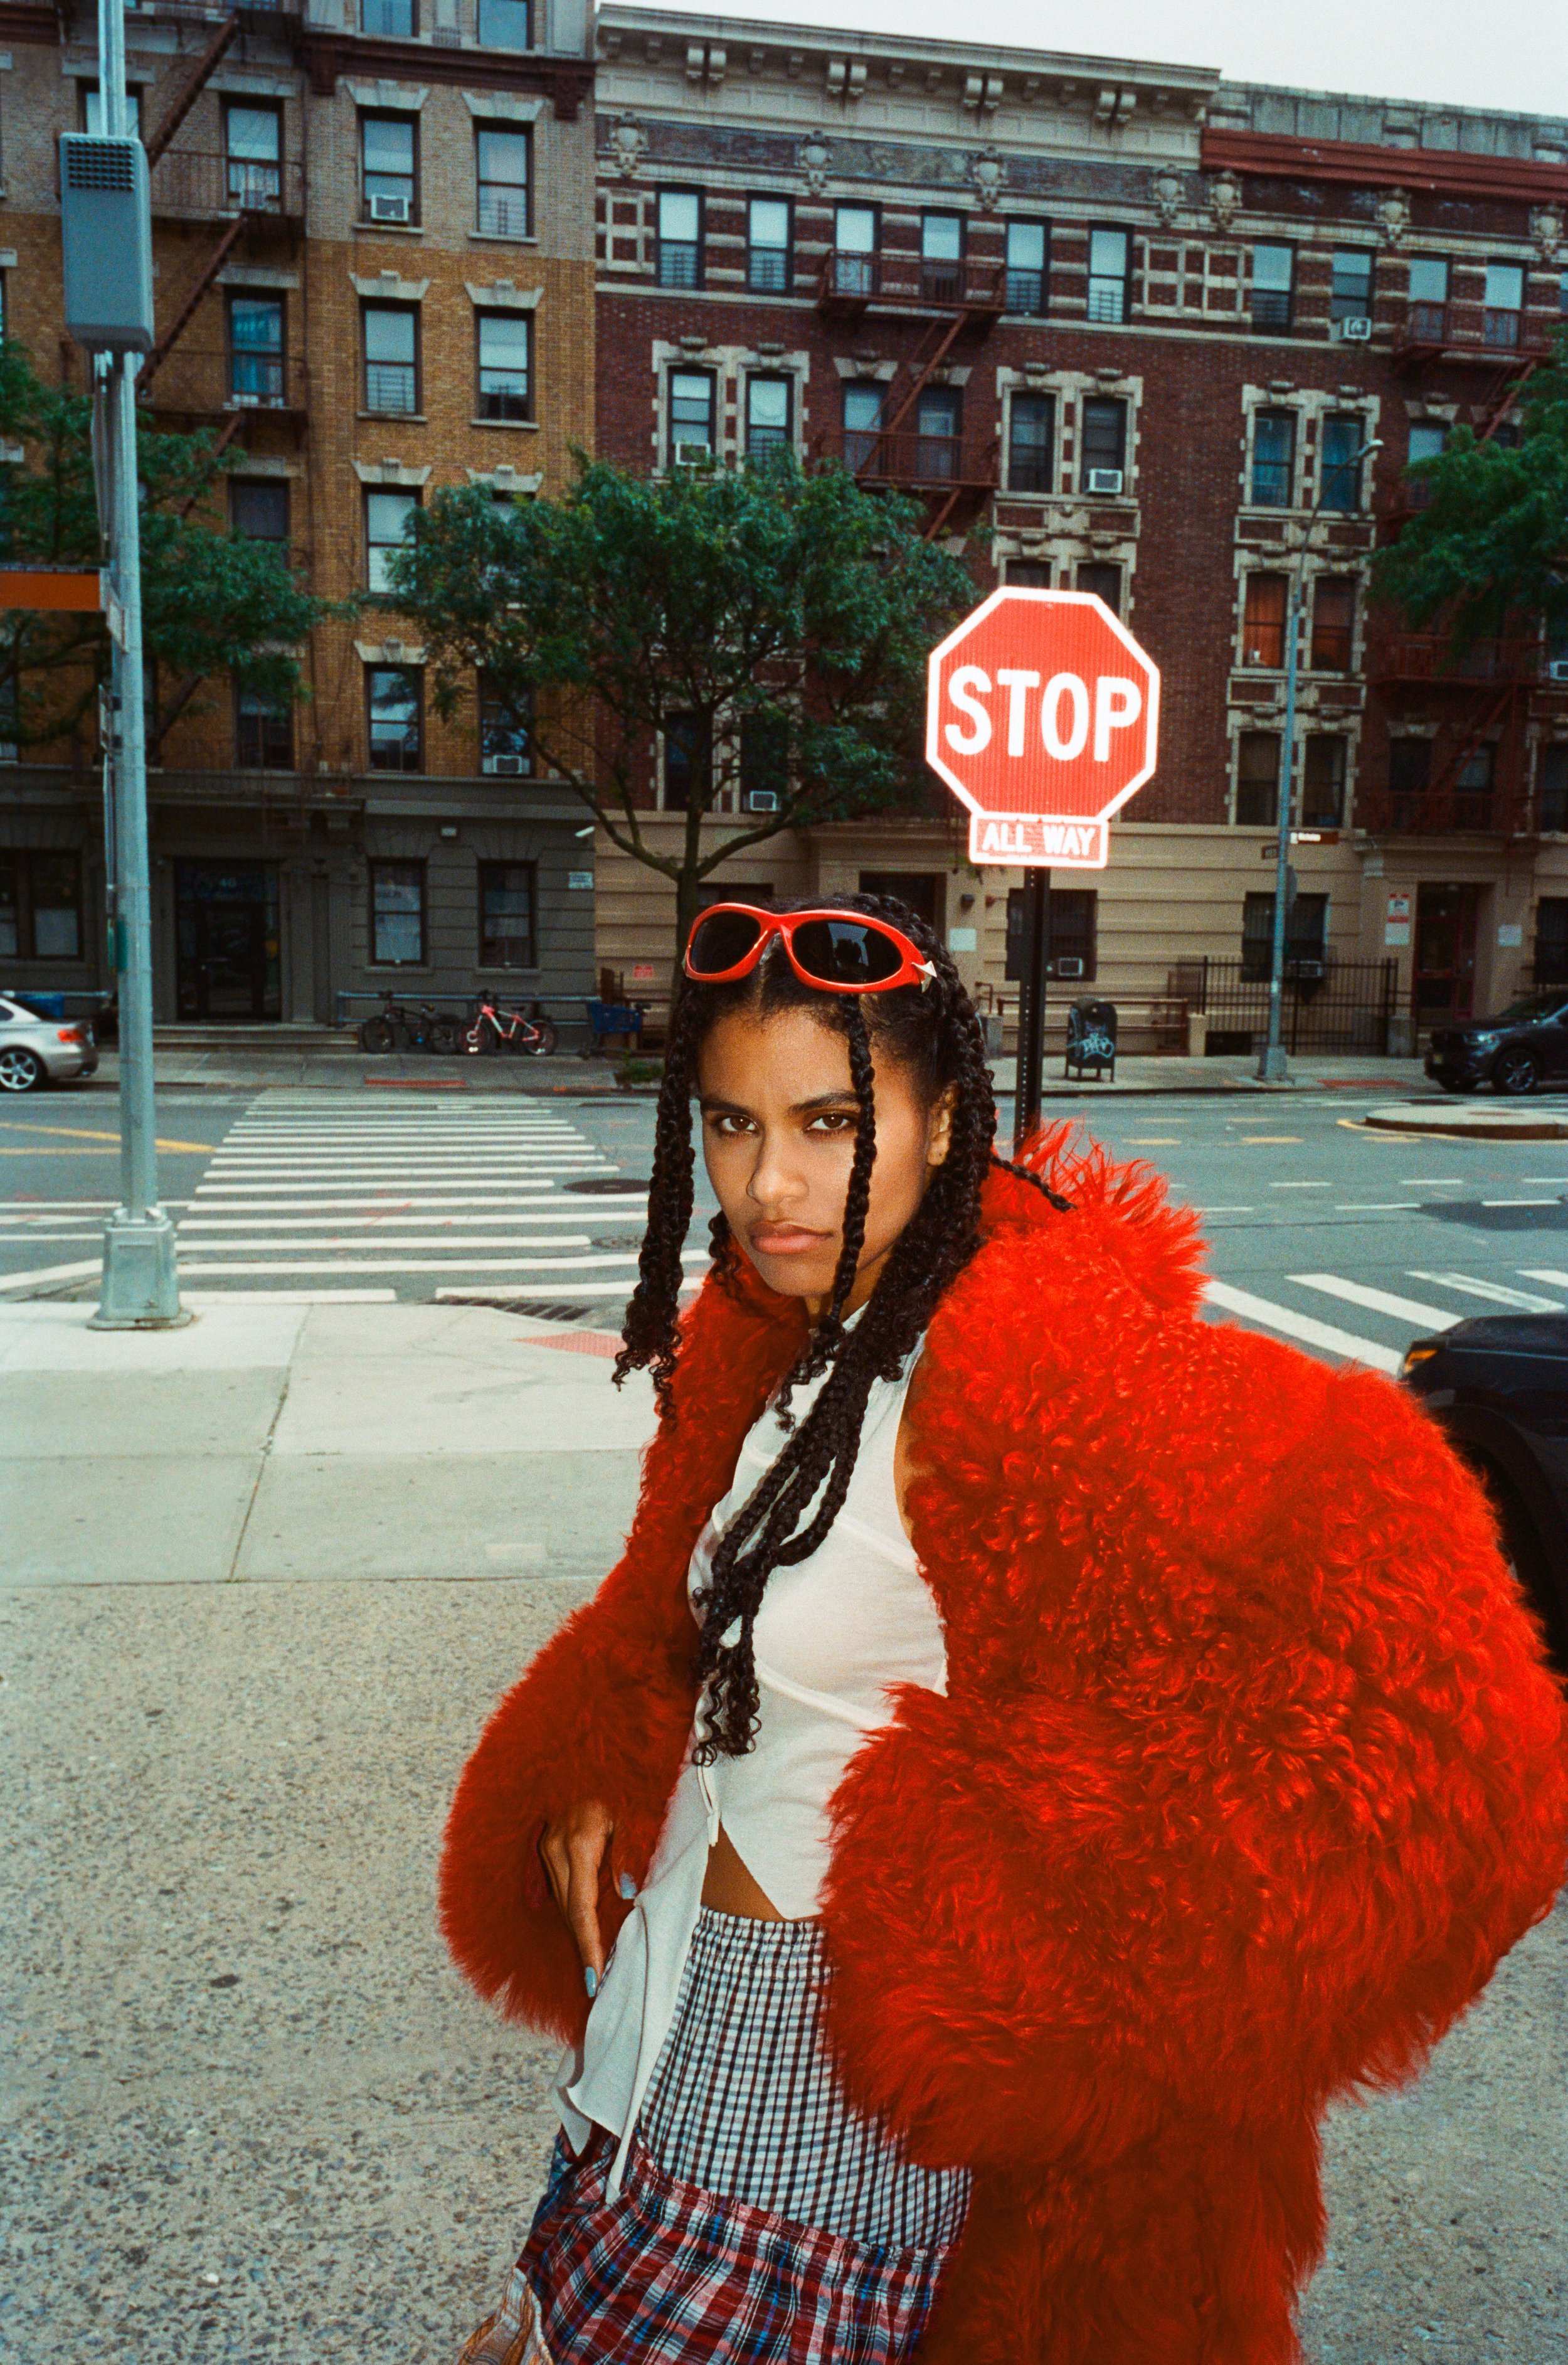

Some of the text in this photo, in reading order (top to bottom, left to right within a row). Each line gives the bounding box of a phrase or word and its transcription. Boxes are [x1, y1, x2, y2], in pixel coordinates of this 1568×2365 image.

[944, 664, 1142, 762] STOP
[981, 822, 1096, 856] ALL WAY
